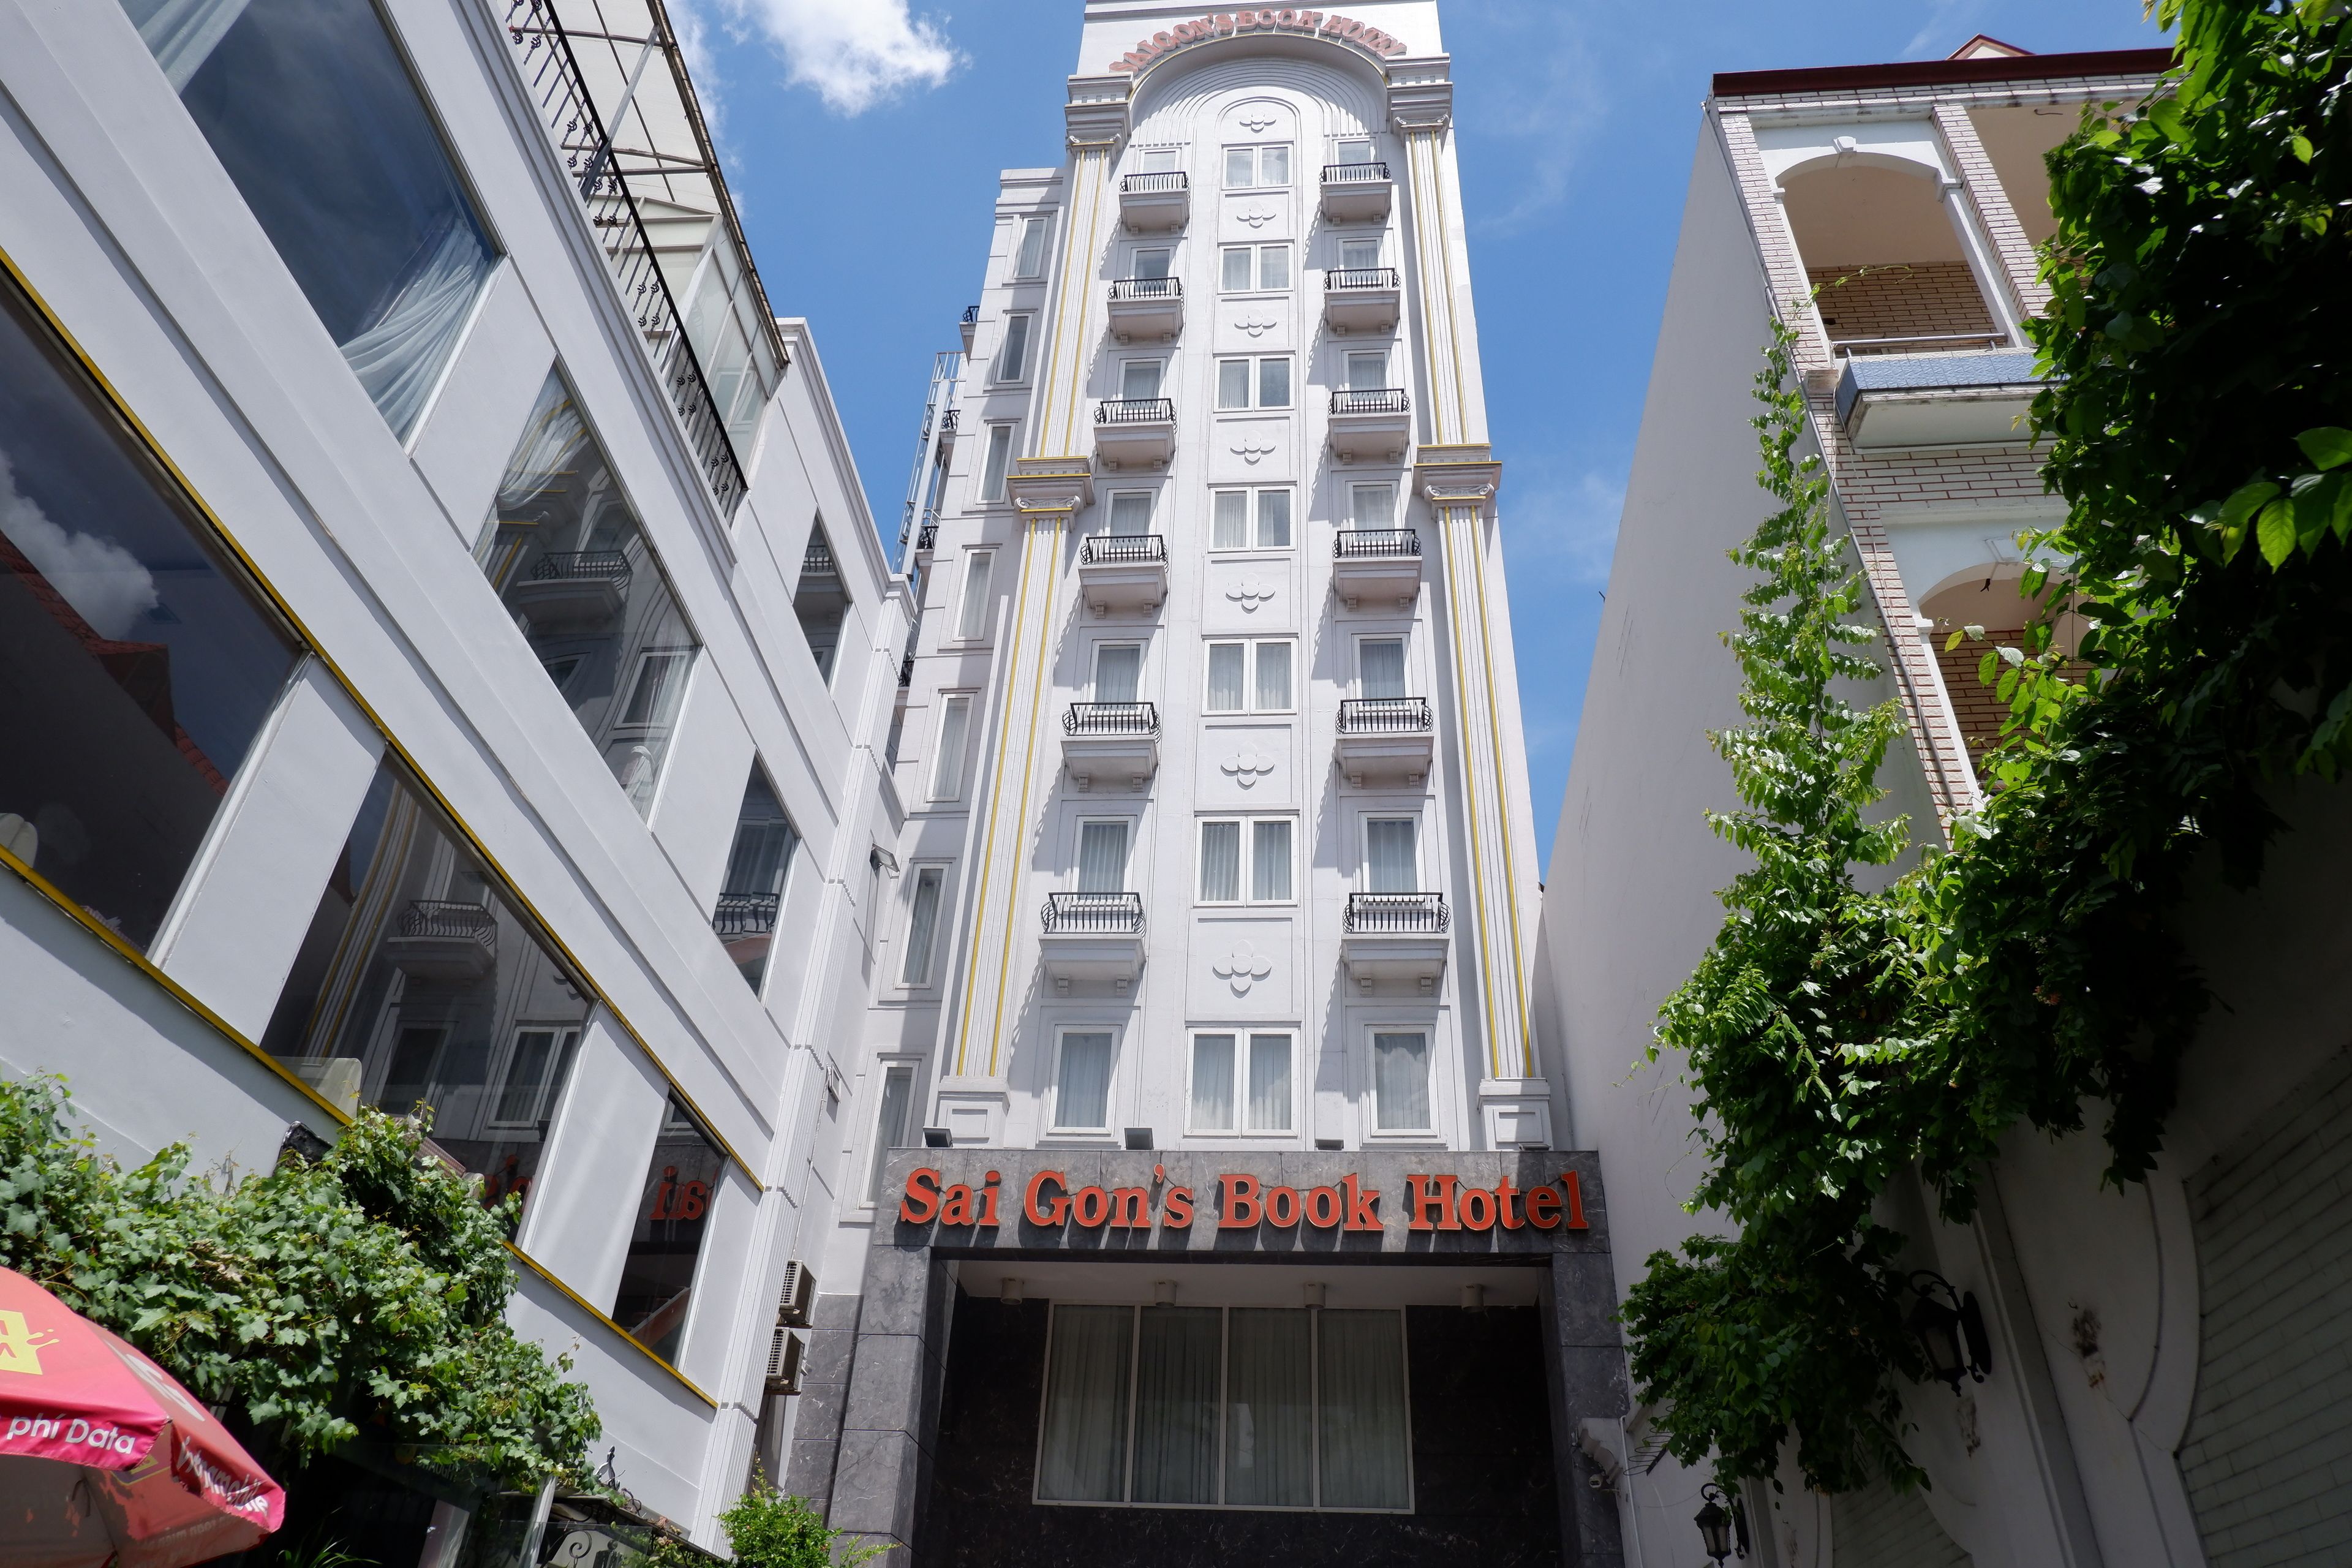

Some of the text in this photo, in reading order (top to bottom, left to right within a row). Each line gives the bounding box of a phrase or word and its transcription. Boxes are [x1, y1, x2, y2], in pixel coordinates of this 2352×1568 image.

[1235, 9, 1323, 32] BOOK
[1319, 15, 1408, 62] HOTEL
[900, 1163, 1589, 1231] Sai Gon's Book Hotel
[7, 1412, 135, 1454] phí Data
